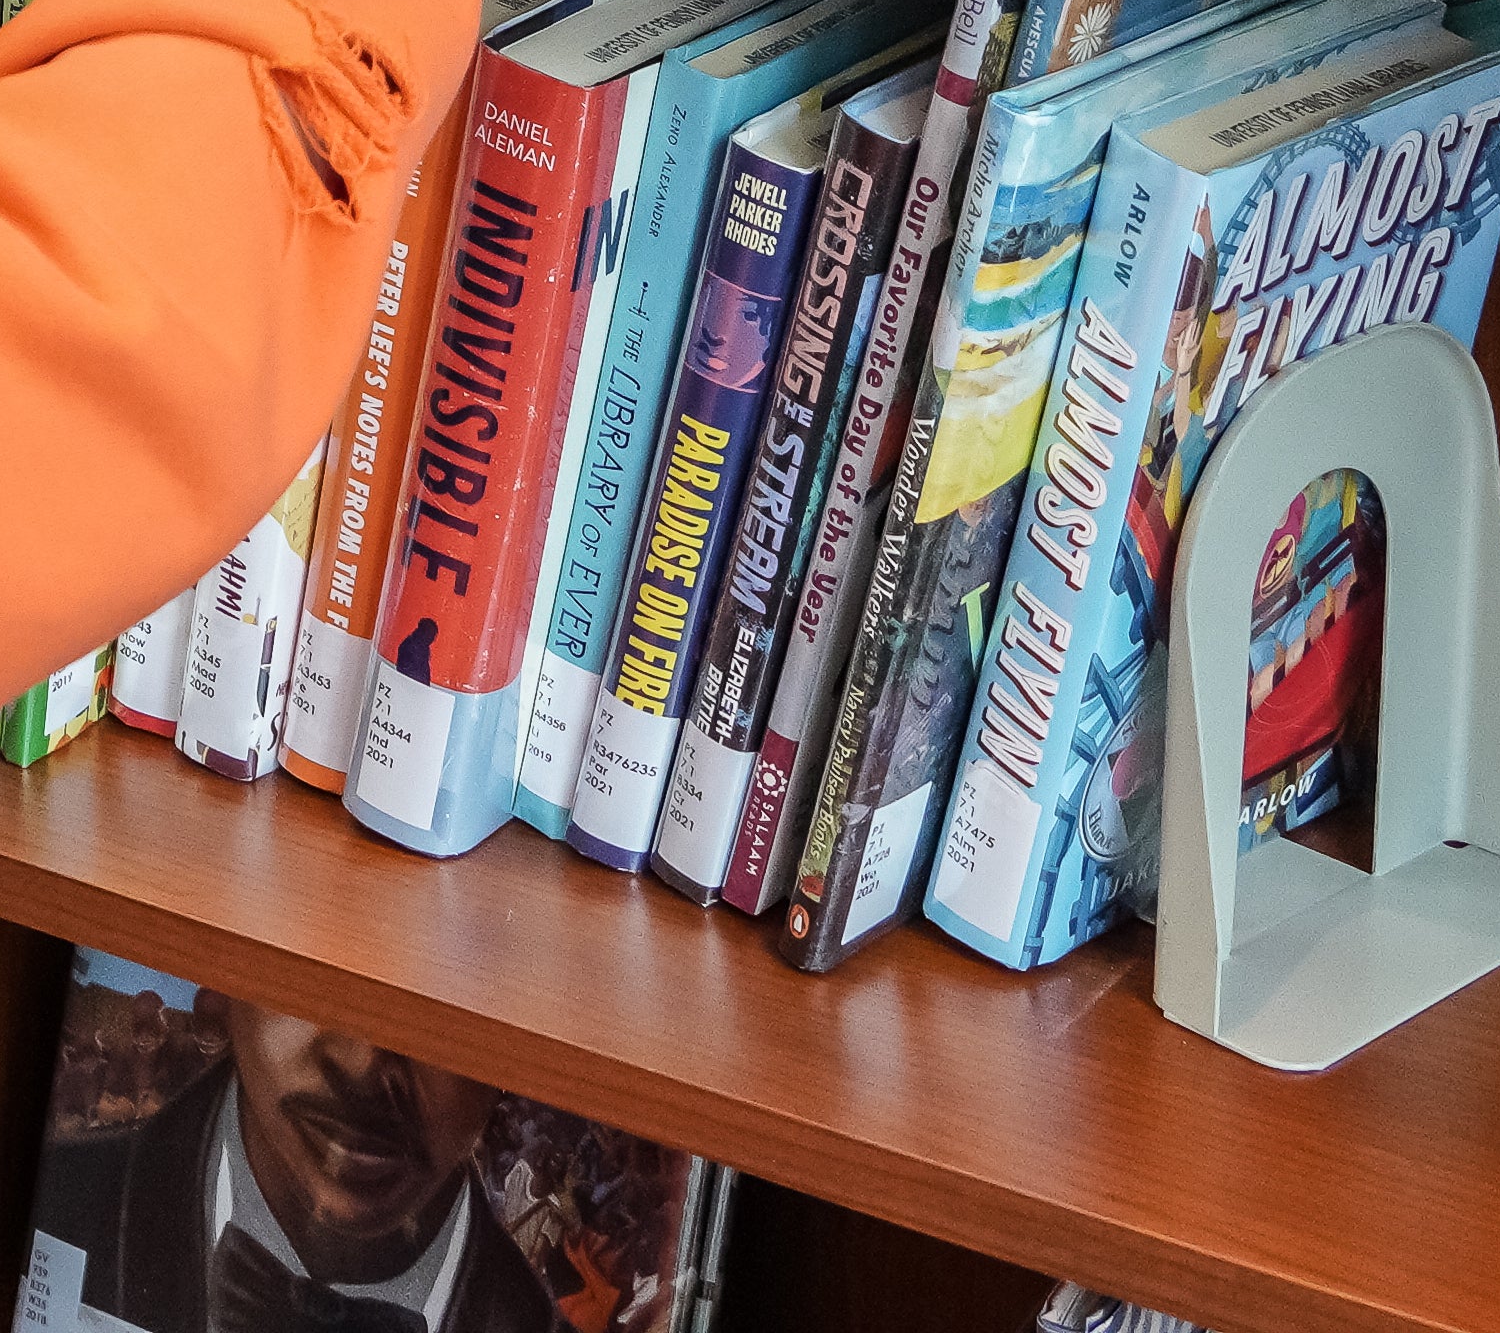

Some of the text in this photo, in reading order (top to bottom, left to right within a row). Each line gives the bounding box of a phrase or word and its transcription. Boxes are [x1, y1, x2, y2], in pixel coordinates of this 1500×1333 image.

[1018, 6, 1046, 78] AMESCUA
[475, 124, 556, 172] ALEMAN
[484, 101, 553, 147] DANIEL
[730, 196, 781, 233] PARKER
[734, 172, 787, 211] JEWELL
[725, 223, 777, 257] RHODES
[1114, 182, 1152, 288] ARLOW
[866, 176, 940, 388] Our Favorite
[399, 178, 538, 599] INDIVISIBLE
[1026, 297, 1138, 590] ALMOST
[888, 417, 936, 522] Wonder
[615, 412, 731, 718] PARADISE FIRE
[194, 645, 222, 668] A345
[365, 745, 395, 768] 2021
[947, 846, 976, 872] 2021
